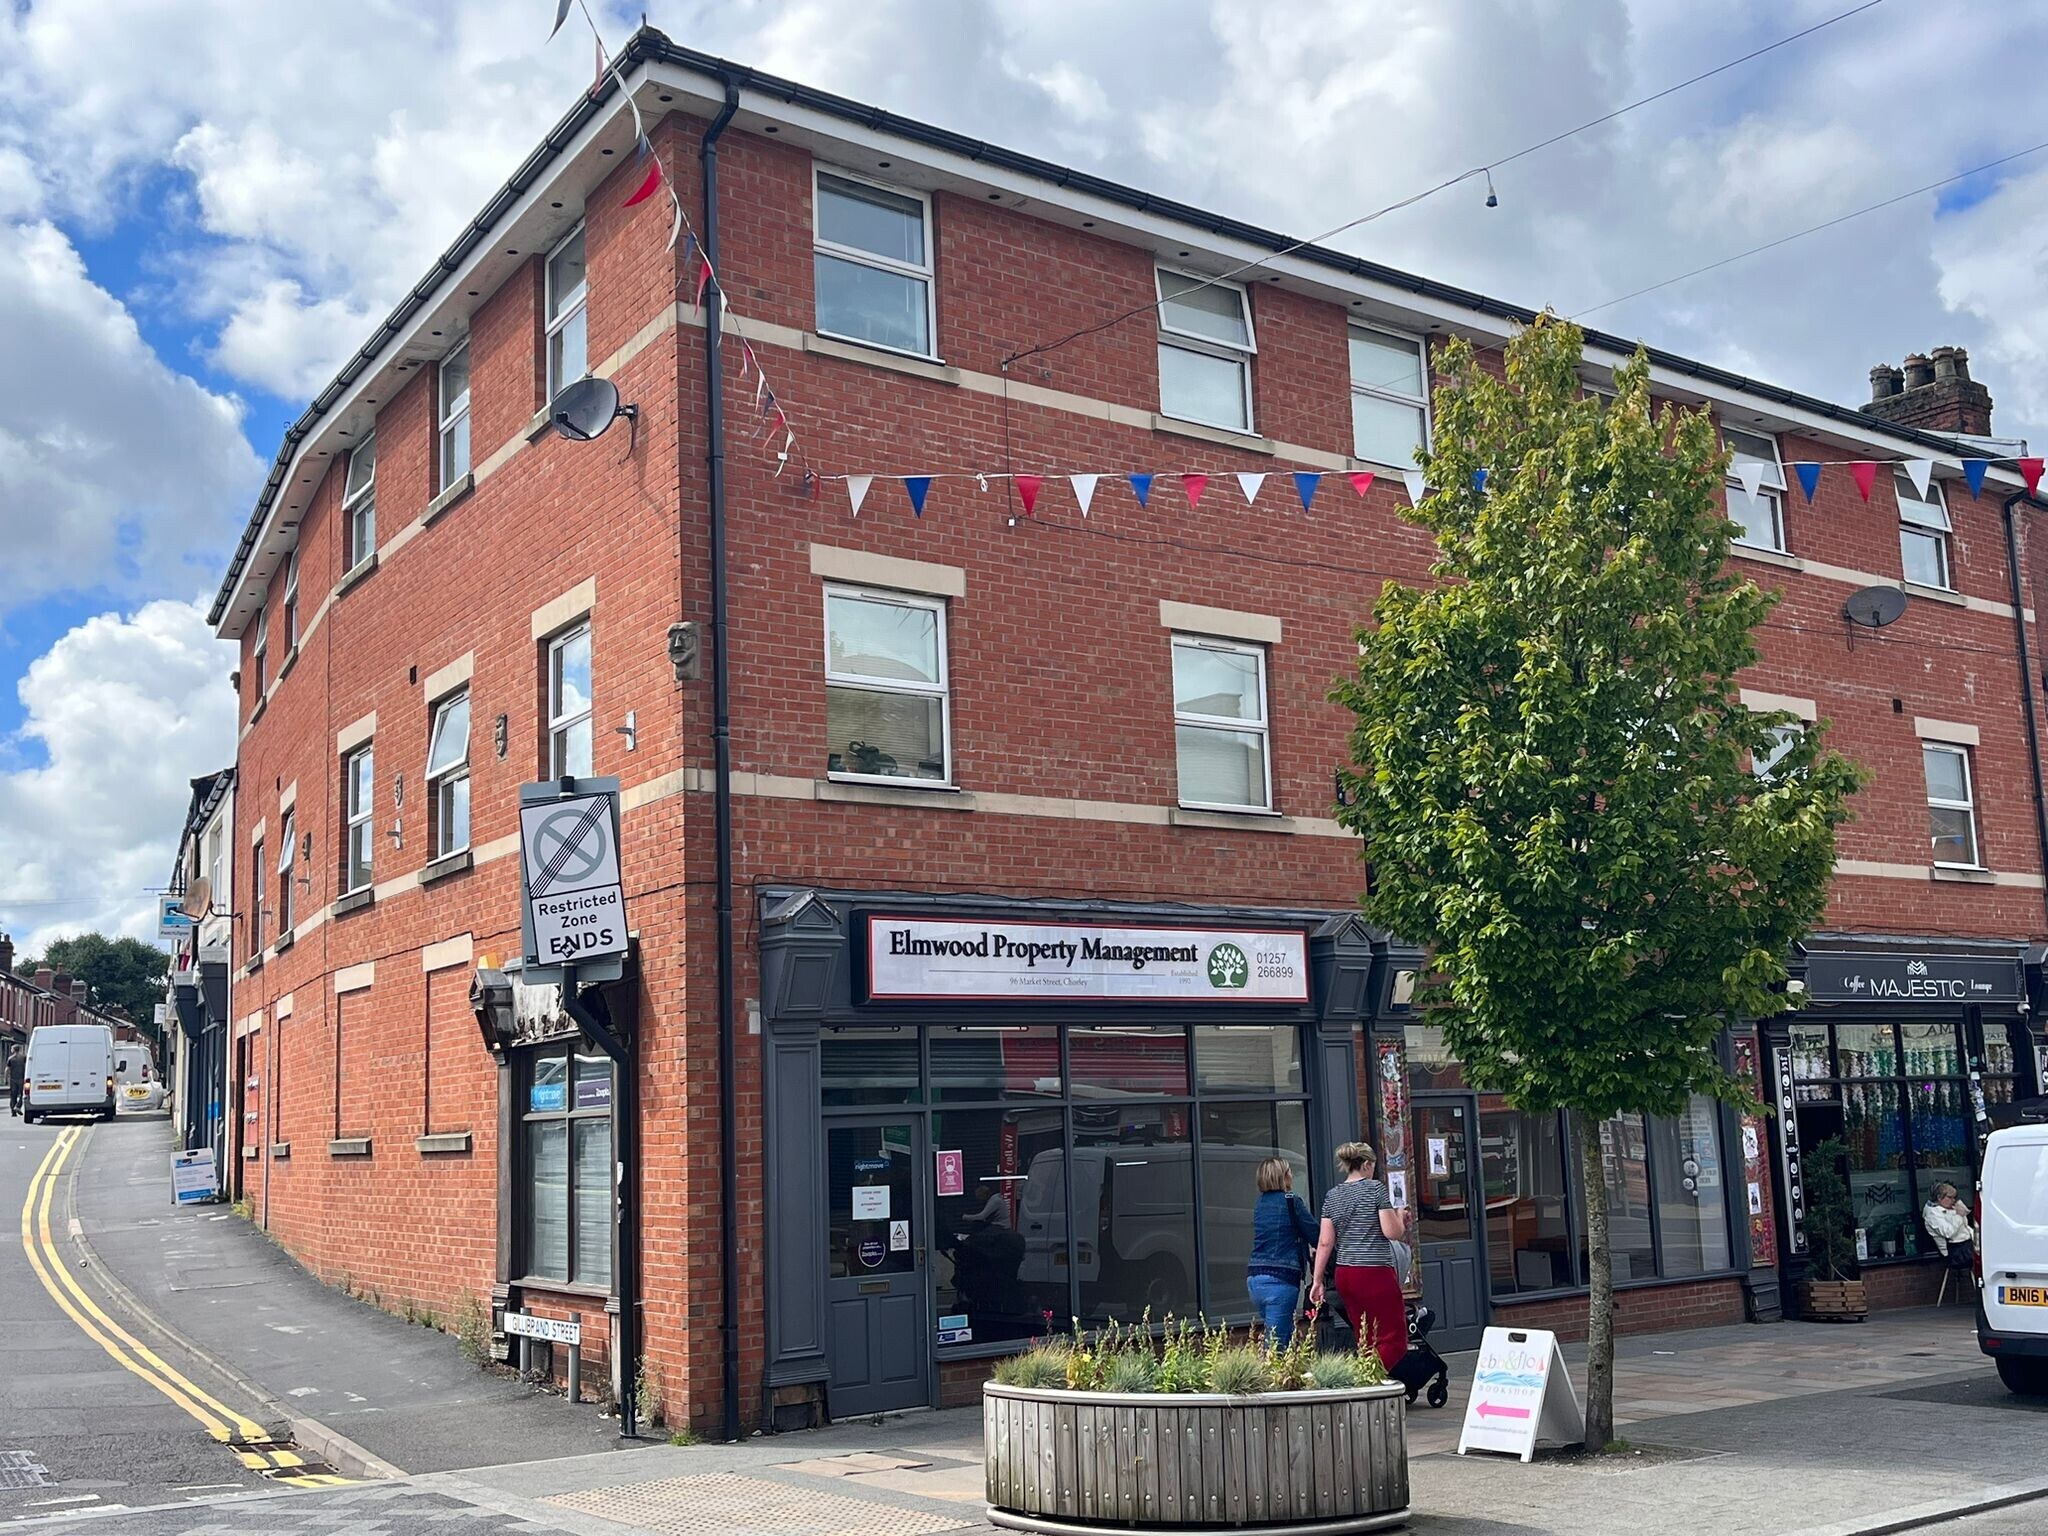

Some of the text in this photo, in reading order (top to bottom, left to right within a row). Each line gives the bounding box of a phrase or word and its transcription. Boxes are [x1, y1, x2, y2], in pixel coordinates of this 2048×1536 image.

[538, 891, 617, 916] Restricted
[561, 914, 597, 928] Zone
[550, 928, 614, 955] ENDS
[889, 930, 1198, 970] Elmwood Property Management
[1256, 952, 1286, 964] 01257
[1257, 966, 1294, 978] 266899
[1009, 977, 1018, 985] 96
[1019, 976, 1042, 986] Market
[1064, 977, 1089, 988] Chorley
[1843, 975, 1993, 998] Coffee MAJESTIC Lounge
[2009, 1287, 2040, 1303] BN16
[552, 1322, 578, 1341] STREET
[1478, 1384, 1536, 1397] BOOKSHOP
